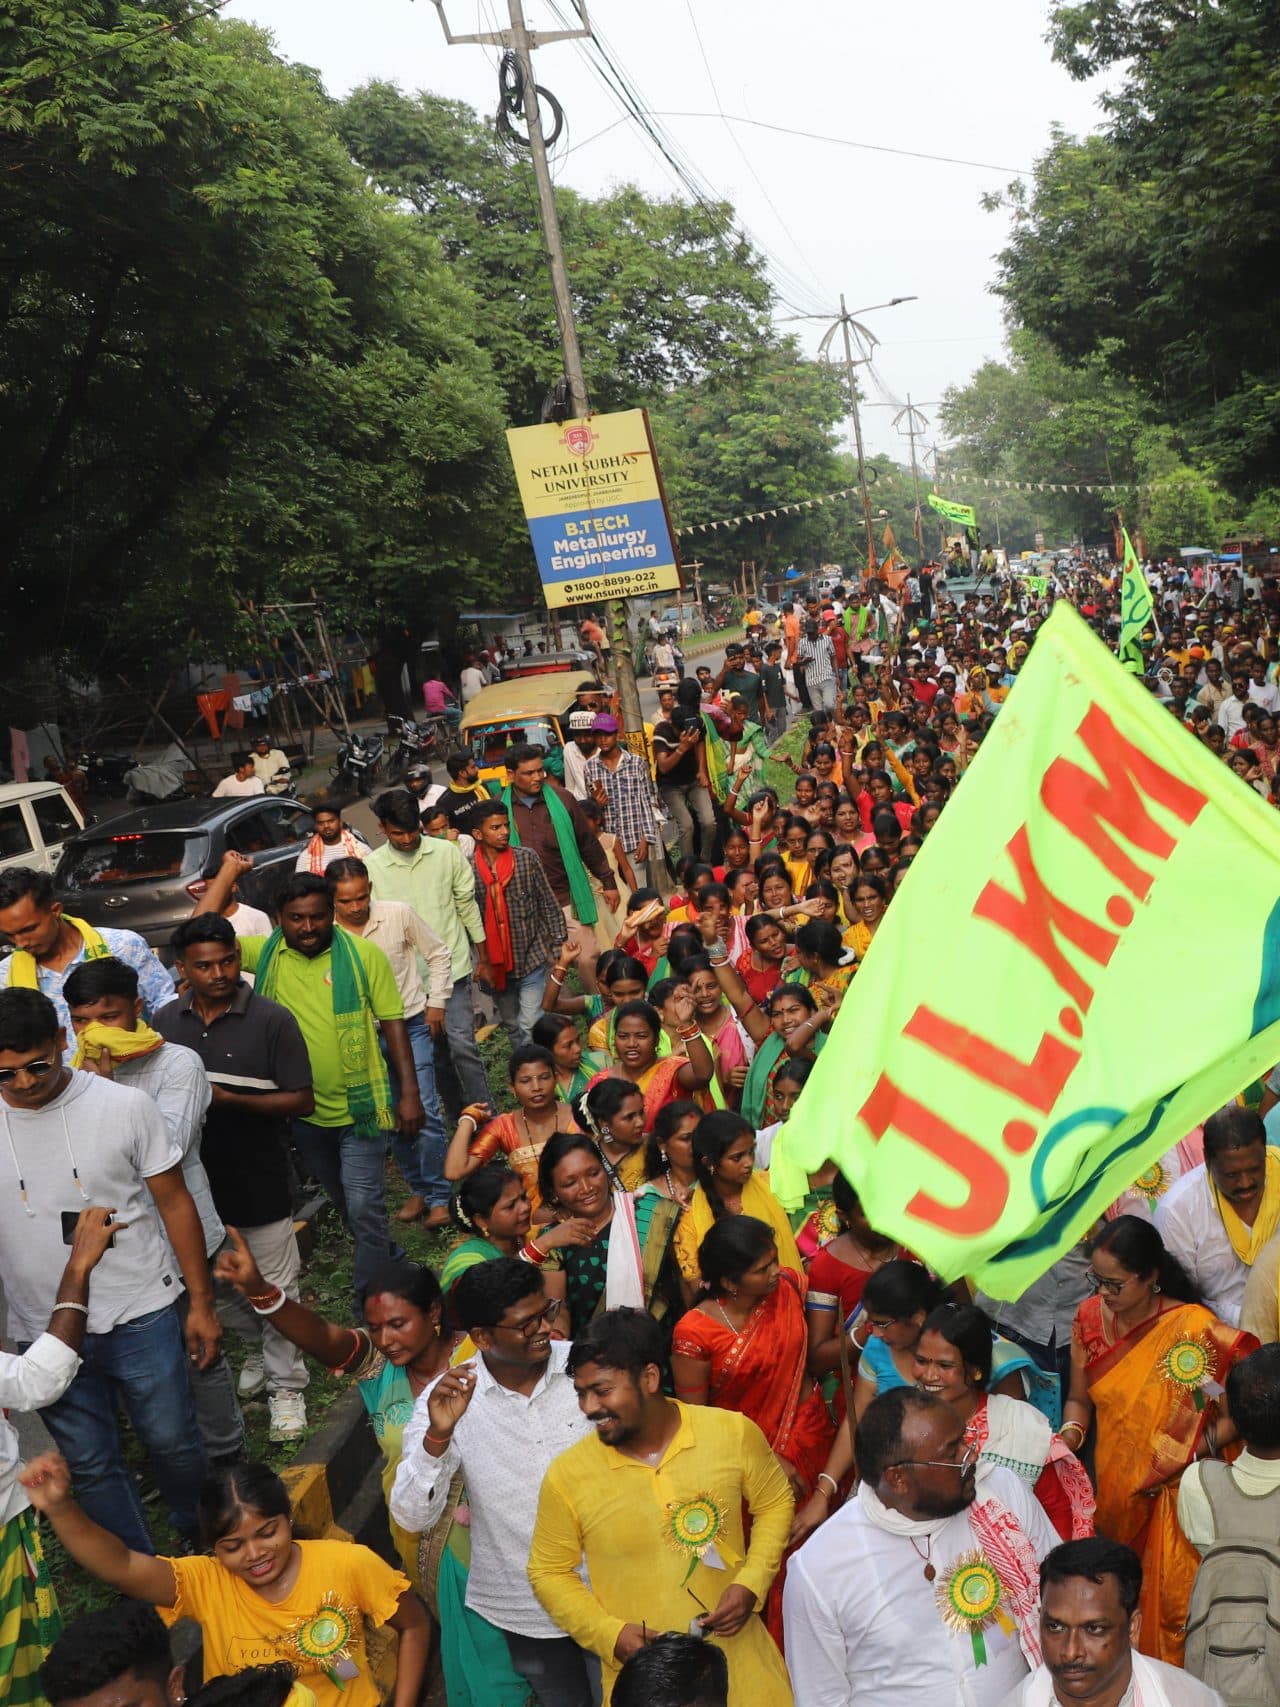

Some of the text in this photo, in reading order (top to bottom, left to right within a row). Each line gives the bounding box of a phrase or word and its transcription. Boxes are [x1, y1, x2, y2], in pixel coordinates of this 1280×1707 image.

[530, 455, 638, 480] NETAJI SUBHAS
[544, 471, 629, 493] UNIVERSITY
[565, 514, 630, 536] B.TECH
[553, 528, 647, 554] Metallurgy
[551, 542, 657, 570] Engineering
[566, 582, 659, 602] www.nsuniv.ac.in
[574, 571, 656, 591] 1800-8899-022
[856, 700, 1210, 1238] J.L.K.M
